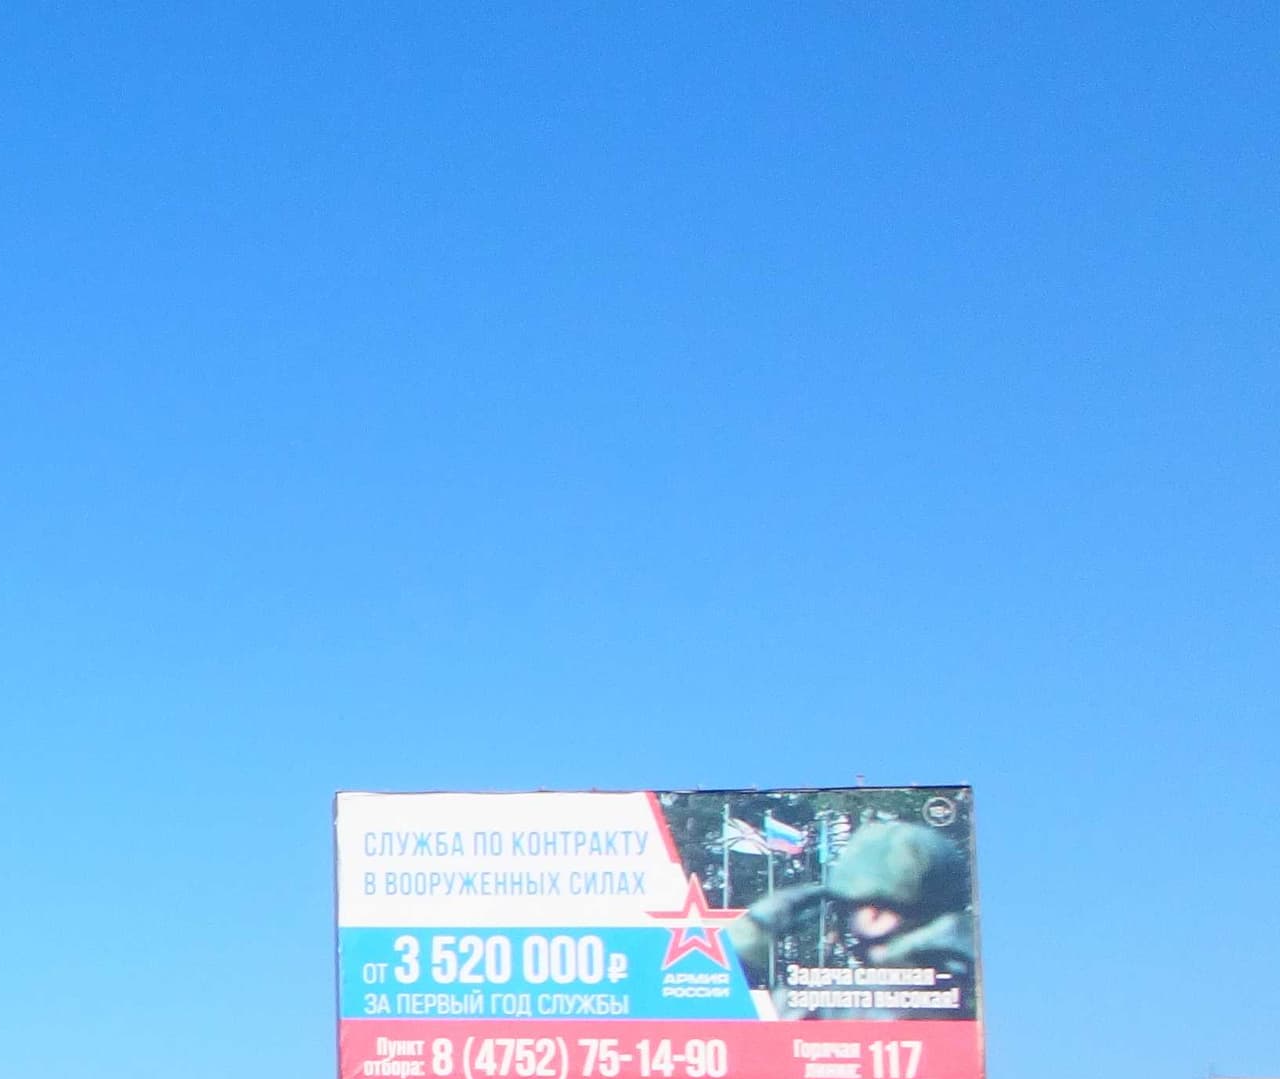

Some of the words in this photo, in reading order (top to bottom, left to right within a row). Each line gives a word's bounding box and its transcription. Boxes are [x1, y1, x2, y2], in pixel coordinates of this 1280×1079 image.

[363, 831, 465, 856] СЛУЖБА
[473, 831, 503, 856] ПО
[511, 830, 649, 856] КОНТРАКТУ
[363, 872, 377, 896] В
[384, 871, 561, 896] ВООРУЖЕННЫХ
[568, 871, 646, 896] СИЛАХ
[393, 935, 421, 985] 3
[430, 935, 513, 985] 520
[662, 972, 731, 985] АРМИЯ
[787, 963, 853, 987] Задача
[363, 993, 391, 1015] ЗА
[396, 988, 486, 1015] ПЕРВЫЙ
[491, 994, 533, 1017] ГОД
[539, 993, 630, 1015] СЛУЖБЫ
[661, 986, 731, 999] РОССИИ
[787, 988, 873, 1011] зарплата
[376, 1036, 426, 1058] Пункт
[431, 1037, 454, 1077] 8
[577, 1037, 729, 1078] 75-14-90
[363, 1058, 426, 1078] отбора:
[867, 1040, 923, 1079] 117
